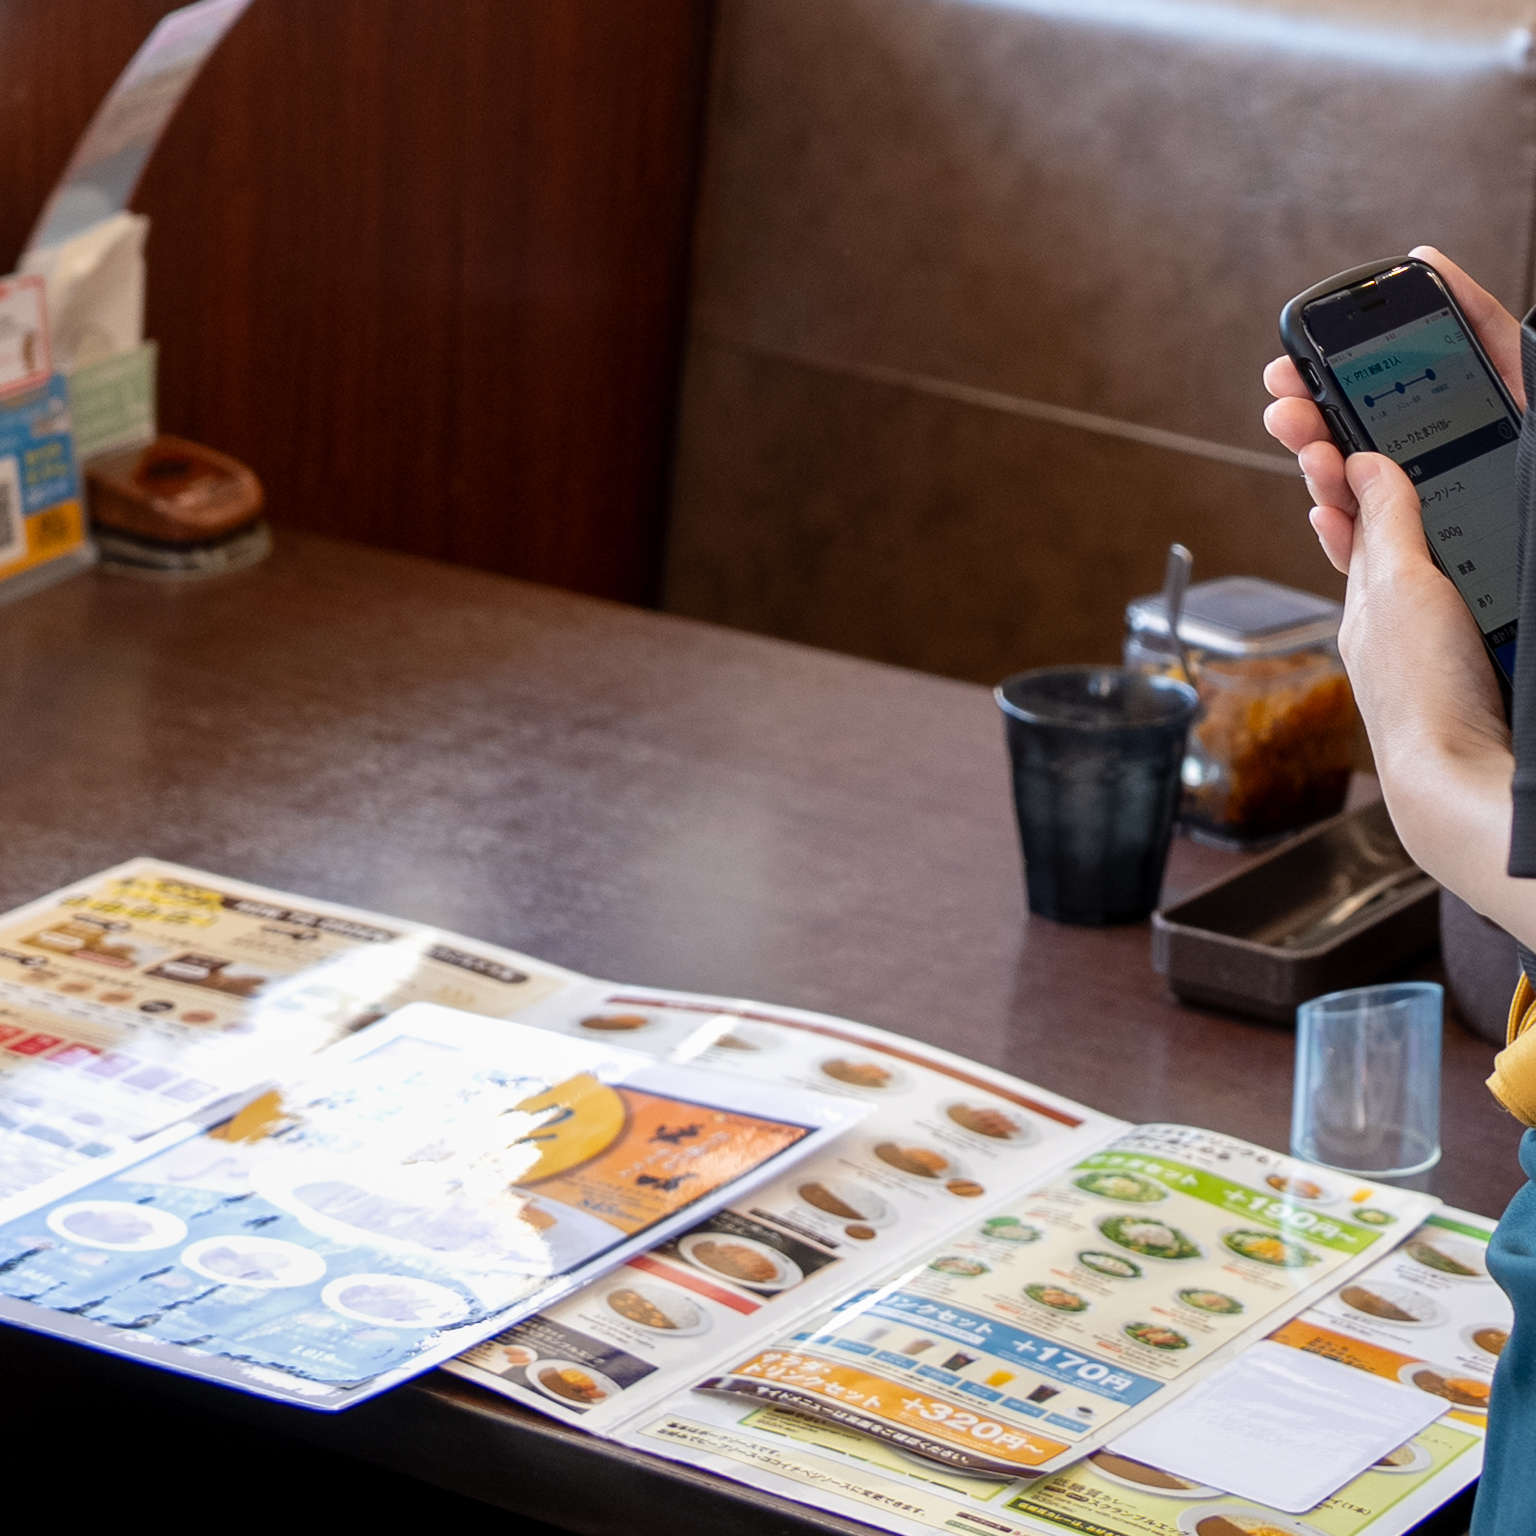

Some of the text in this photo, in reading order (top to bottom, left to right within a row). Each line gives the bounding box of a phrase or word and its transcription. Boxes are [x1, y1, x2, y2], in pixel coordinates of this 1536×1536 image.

[1408, 465, 1422, 478] 人目
[1438, 526, 1463, 542] 300g
[1457, 559, 1476, 575] 普通
[1477, 594, 1493, 608] あり
[864, 1289, 995, 1335] リンクセット
[1012, 1338, 1135, 1394] +170円
[743, 1362, 1044, 1457] ドリンクセット +320円～
[1052, 1476, 1136, 1510] 低糖質カレー
